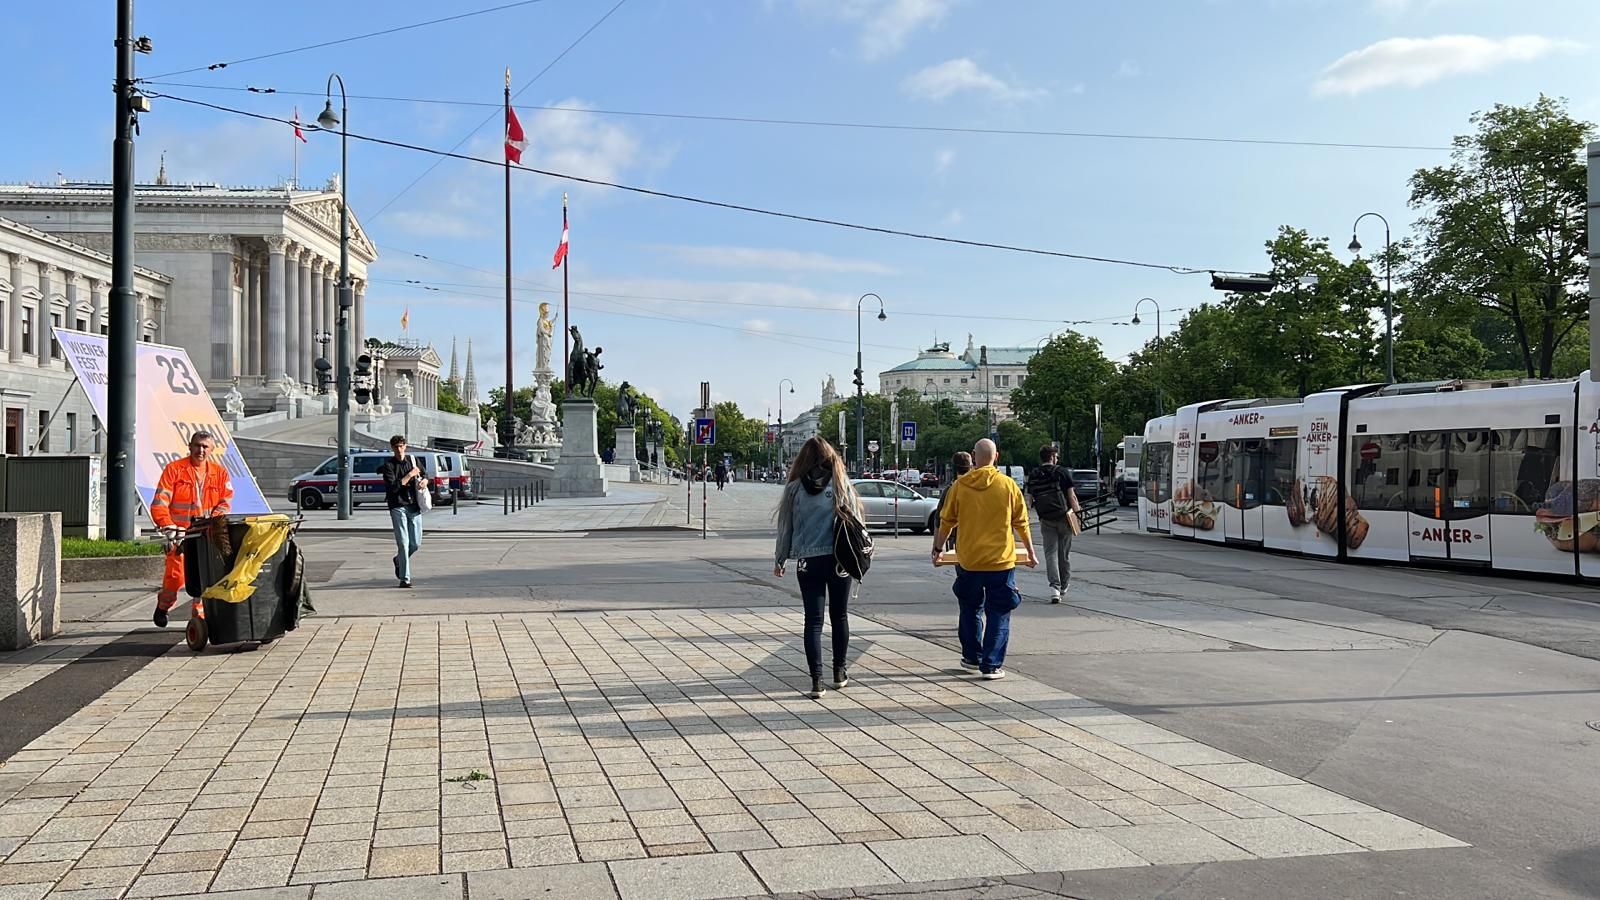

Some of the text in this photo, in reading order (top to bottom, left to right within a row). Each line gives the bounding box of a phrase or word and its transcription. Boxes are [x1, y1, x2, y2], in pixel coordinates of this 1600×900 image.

[67, 341, 107, 358] WIENER
[75, 356, 100, 371] FEST
[83, 371, 108, 385] WOC
[156, 355, 200, 395] 23
[1233, 412, 1259, 425] ANKER
[1311, 422, 1329, 432] DEIN
[1306, 432, 1332, 442] ANKER
[1422, 527, 1472, 543] ANKER
